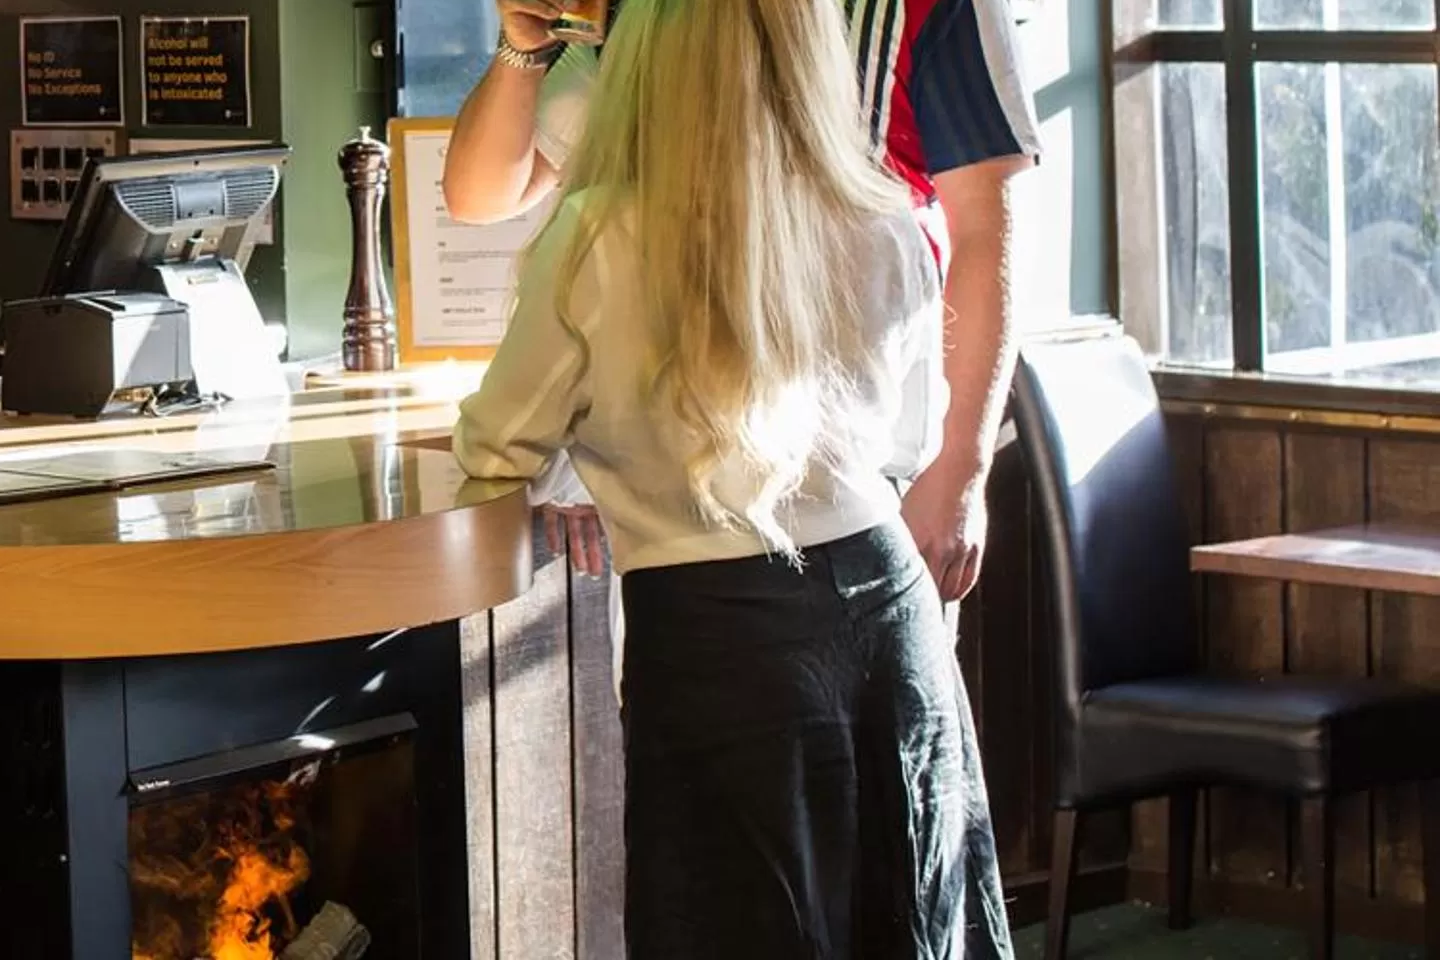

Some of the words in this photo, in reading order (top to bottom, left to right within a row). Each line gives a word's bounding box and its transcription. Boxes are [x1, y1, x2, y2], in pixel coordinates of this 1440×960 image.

[148, 36, 188, 50] Alcohol
[190, 35, 208, 49] will
[149, 54, 166, 67] not
[168, 54, 183, 67] be
[185, 53, 224, 67] served
[44, 67, 83, 79] Service
[149, 72, 160, 84] to
[163, 72, 202, 85] anyone
[204, 71, 228, 84] who
[44, 83, 103, 96] Exceptions
[149, 88, 159, 101] is
[161, 88, 223, 101] intoxicated
